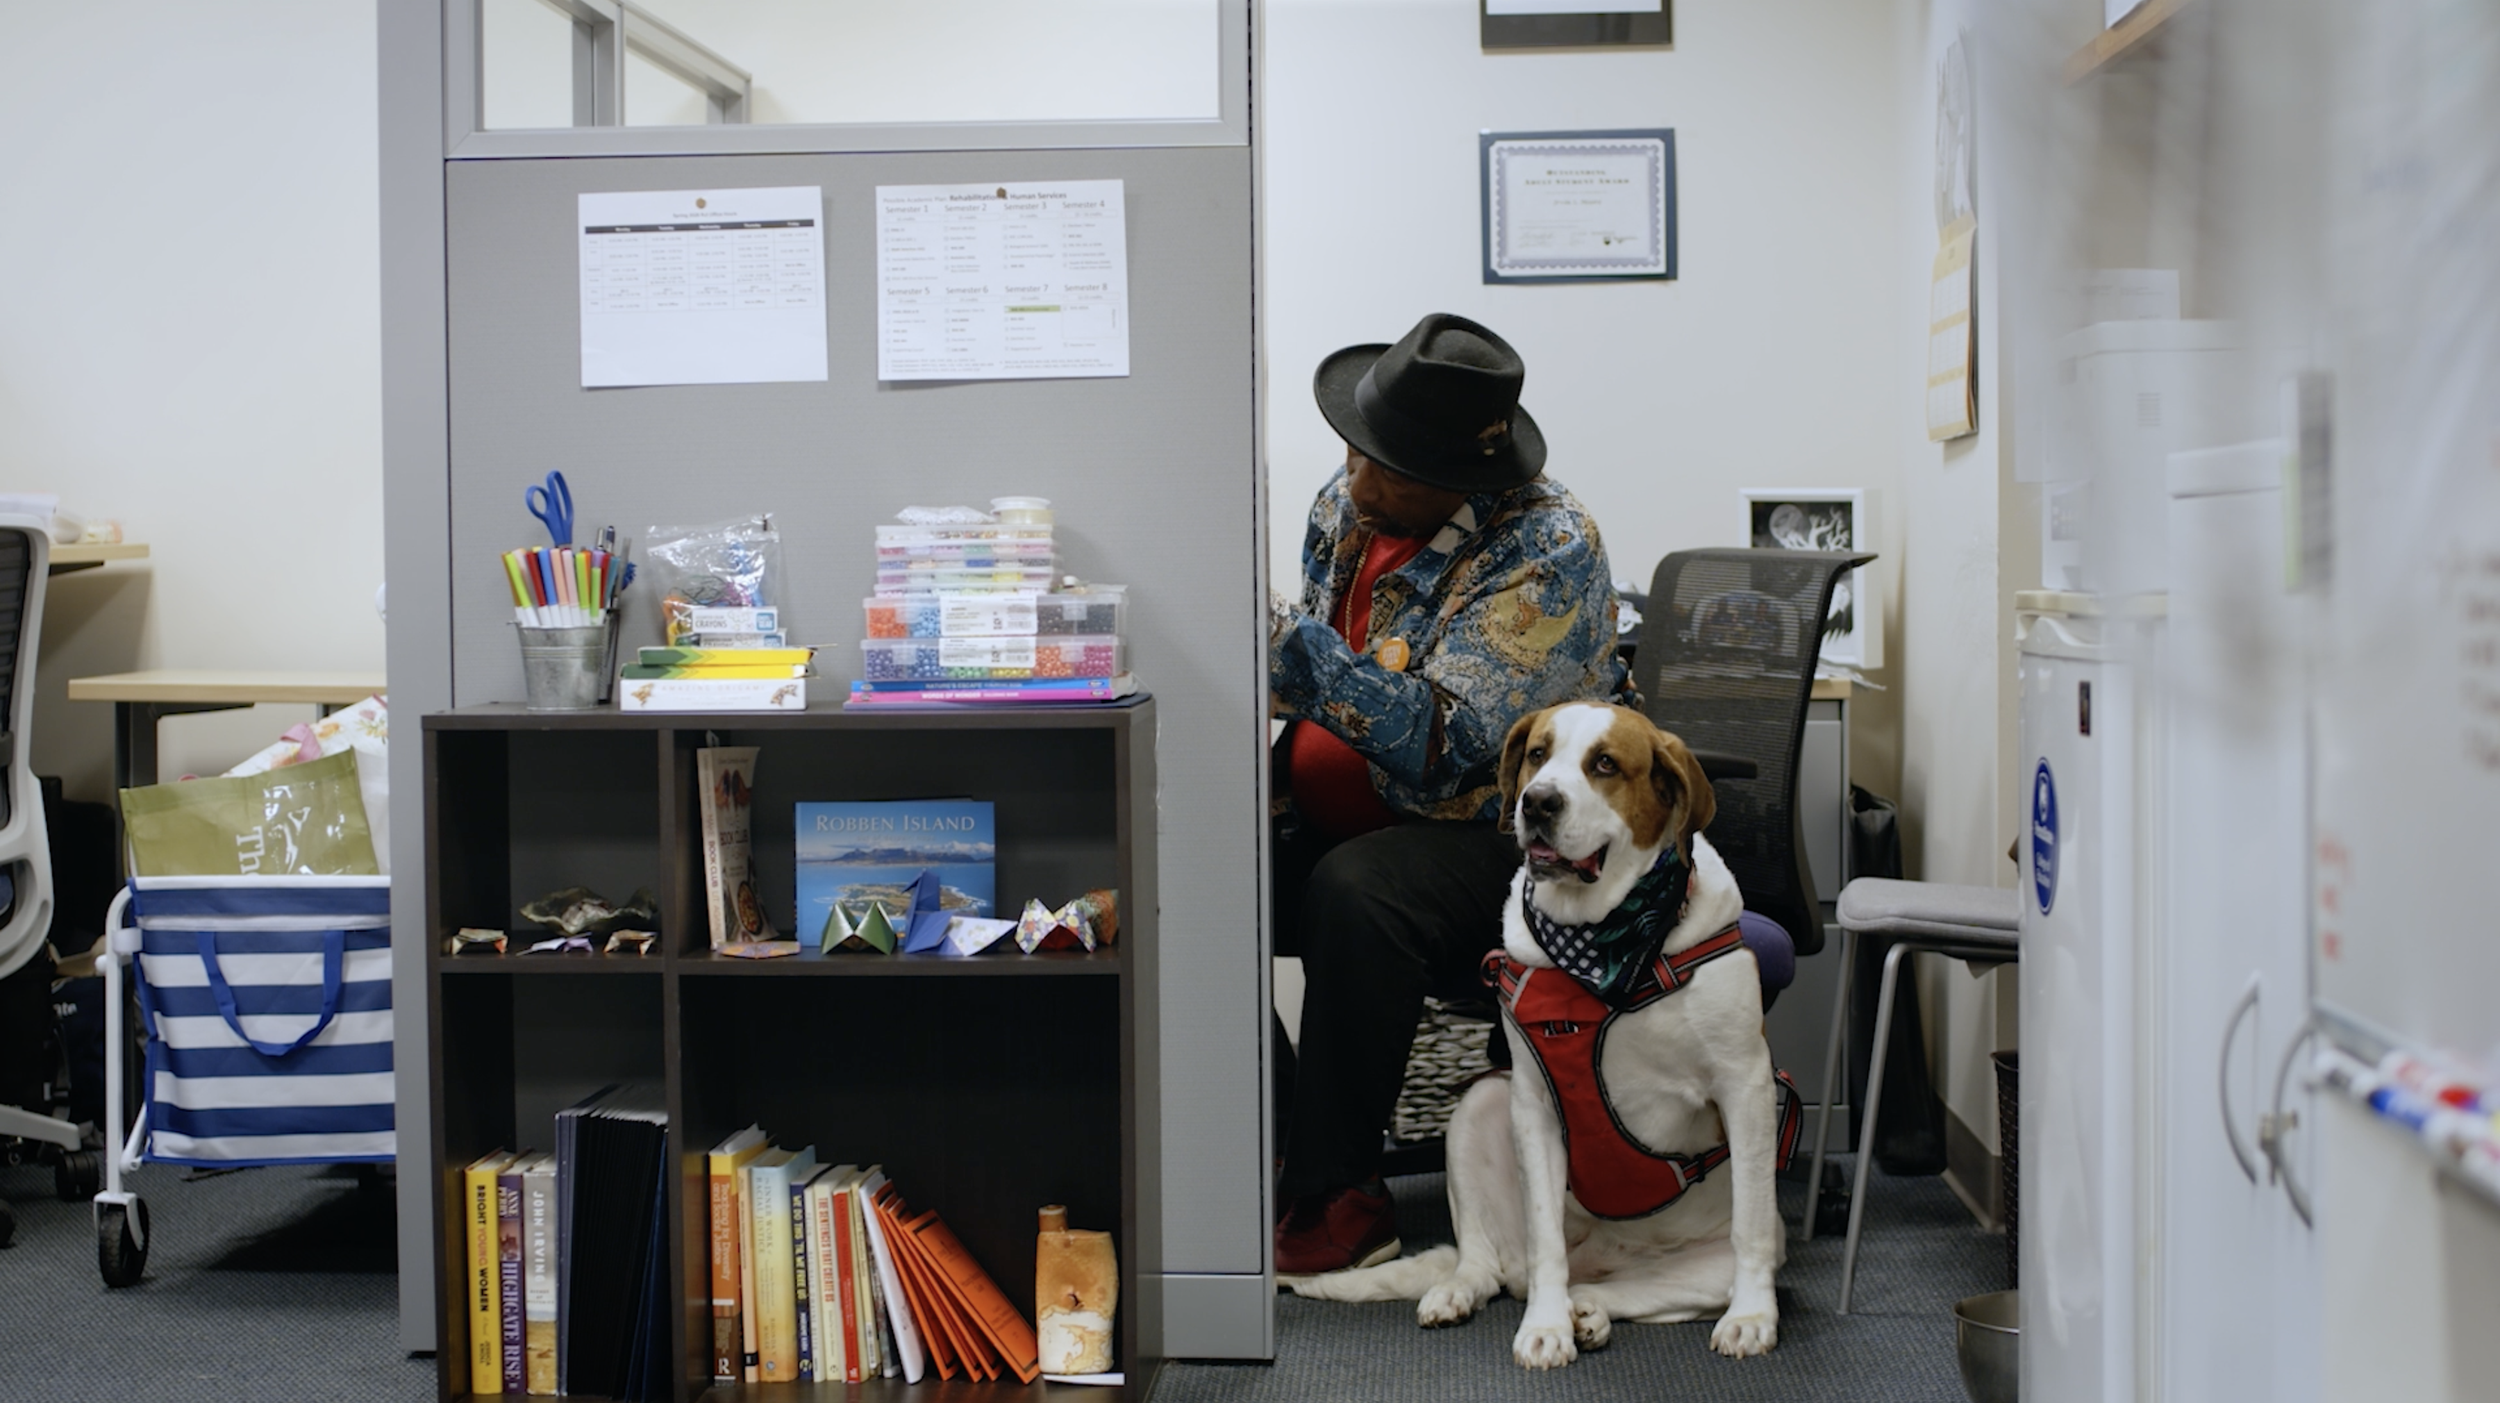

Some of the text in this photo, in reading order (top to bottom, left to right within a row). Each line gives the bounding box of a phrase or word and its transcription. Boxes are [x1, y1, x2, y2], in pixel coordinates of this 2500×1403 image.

[1038, 191, 1067, 200] Services
[885, 205, 921, 214] Semester
[944, 204, 980, 212] Semester
[1004, 202, 1039, 211] Semester
[1062, 201, 1097, 209] Semester
[887, 287, 922, 296] Semester
[946, 286, 981, 294] Semester
[1005, 285, 1040, 293] Semester
[1064, 284, 1099, 292] Semester
[695, 620, 727, 628] CRAYONS
[661, 683, 765, 692] AMAZING ORIGAMI
[816, 814, 975, 832] ROBBEN ISLAND
[236, 825, 265, 876] Th
[709, 840, 717, 865] BOOK
[710, 866, 718, 888] CLUB
[508, 1189, 519, 1216] ANNE
[764, 1186, 773, 1217] INNER
[792, 1194, 803, 1207] WE
[713, 1203, 721, 1232] Social
[756, 1177, 766, 1254] RACIAL JUSTICE
[793, 1208, 803, 1221] DO
[532, 1190, 546, 1283] JOHN IRVING
[721, 1182, 732, 1281] Teaching for Diversity
[765, 1219, 774, 1247] WORK
[793, 1222, 804, 1240] THIS
[477, 1185, 489, 1312] BRIGHT YOUNG WOMEN
[713, 1233, 722, 1265] Justice
[818, 1197, 835, 1303] THE SENTENCES THAT CREATE US
[795, 1255, 806, 1268] WE
[796, 1269, 807, 1287] FREE
[797, 1288, 808, 1300] US
[502, 1262, 521, 1380] HIGHGATE RISE
[718, 1357, 731, 1375] R
